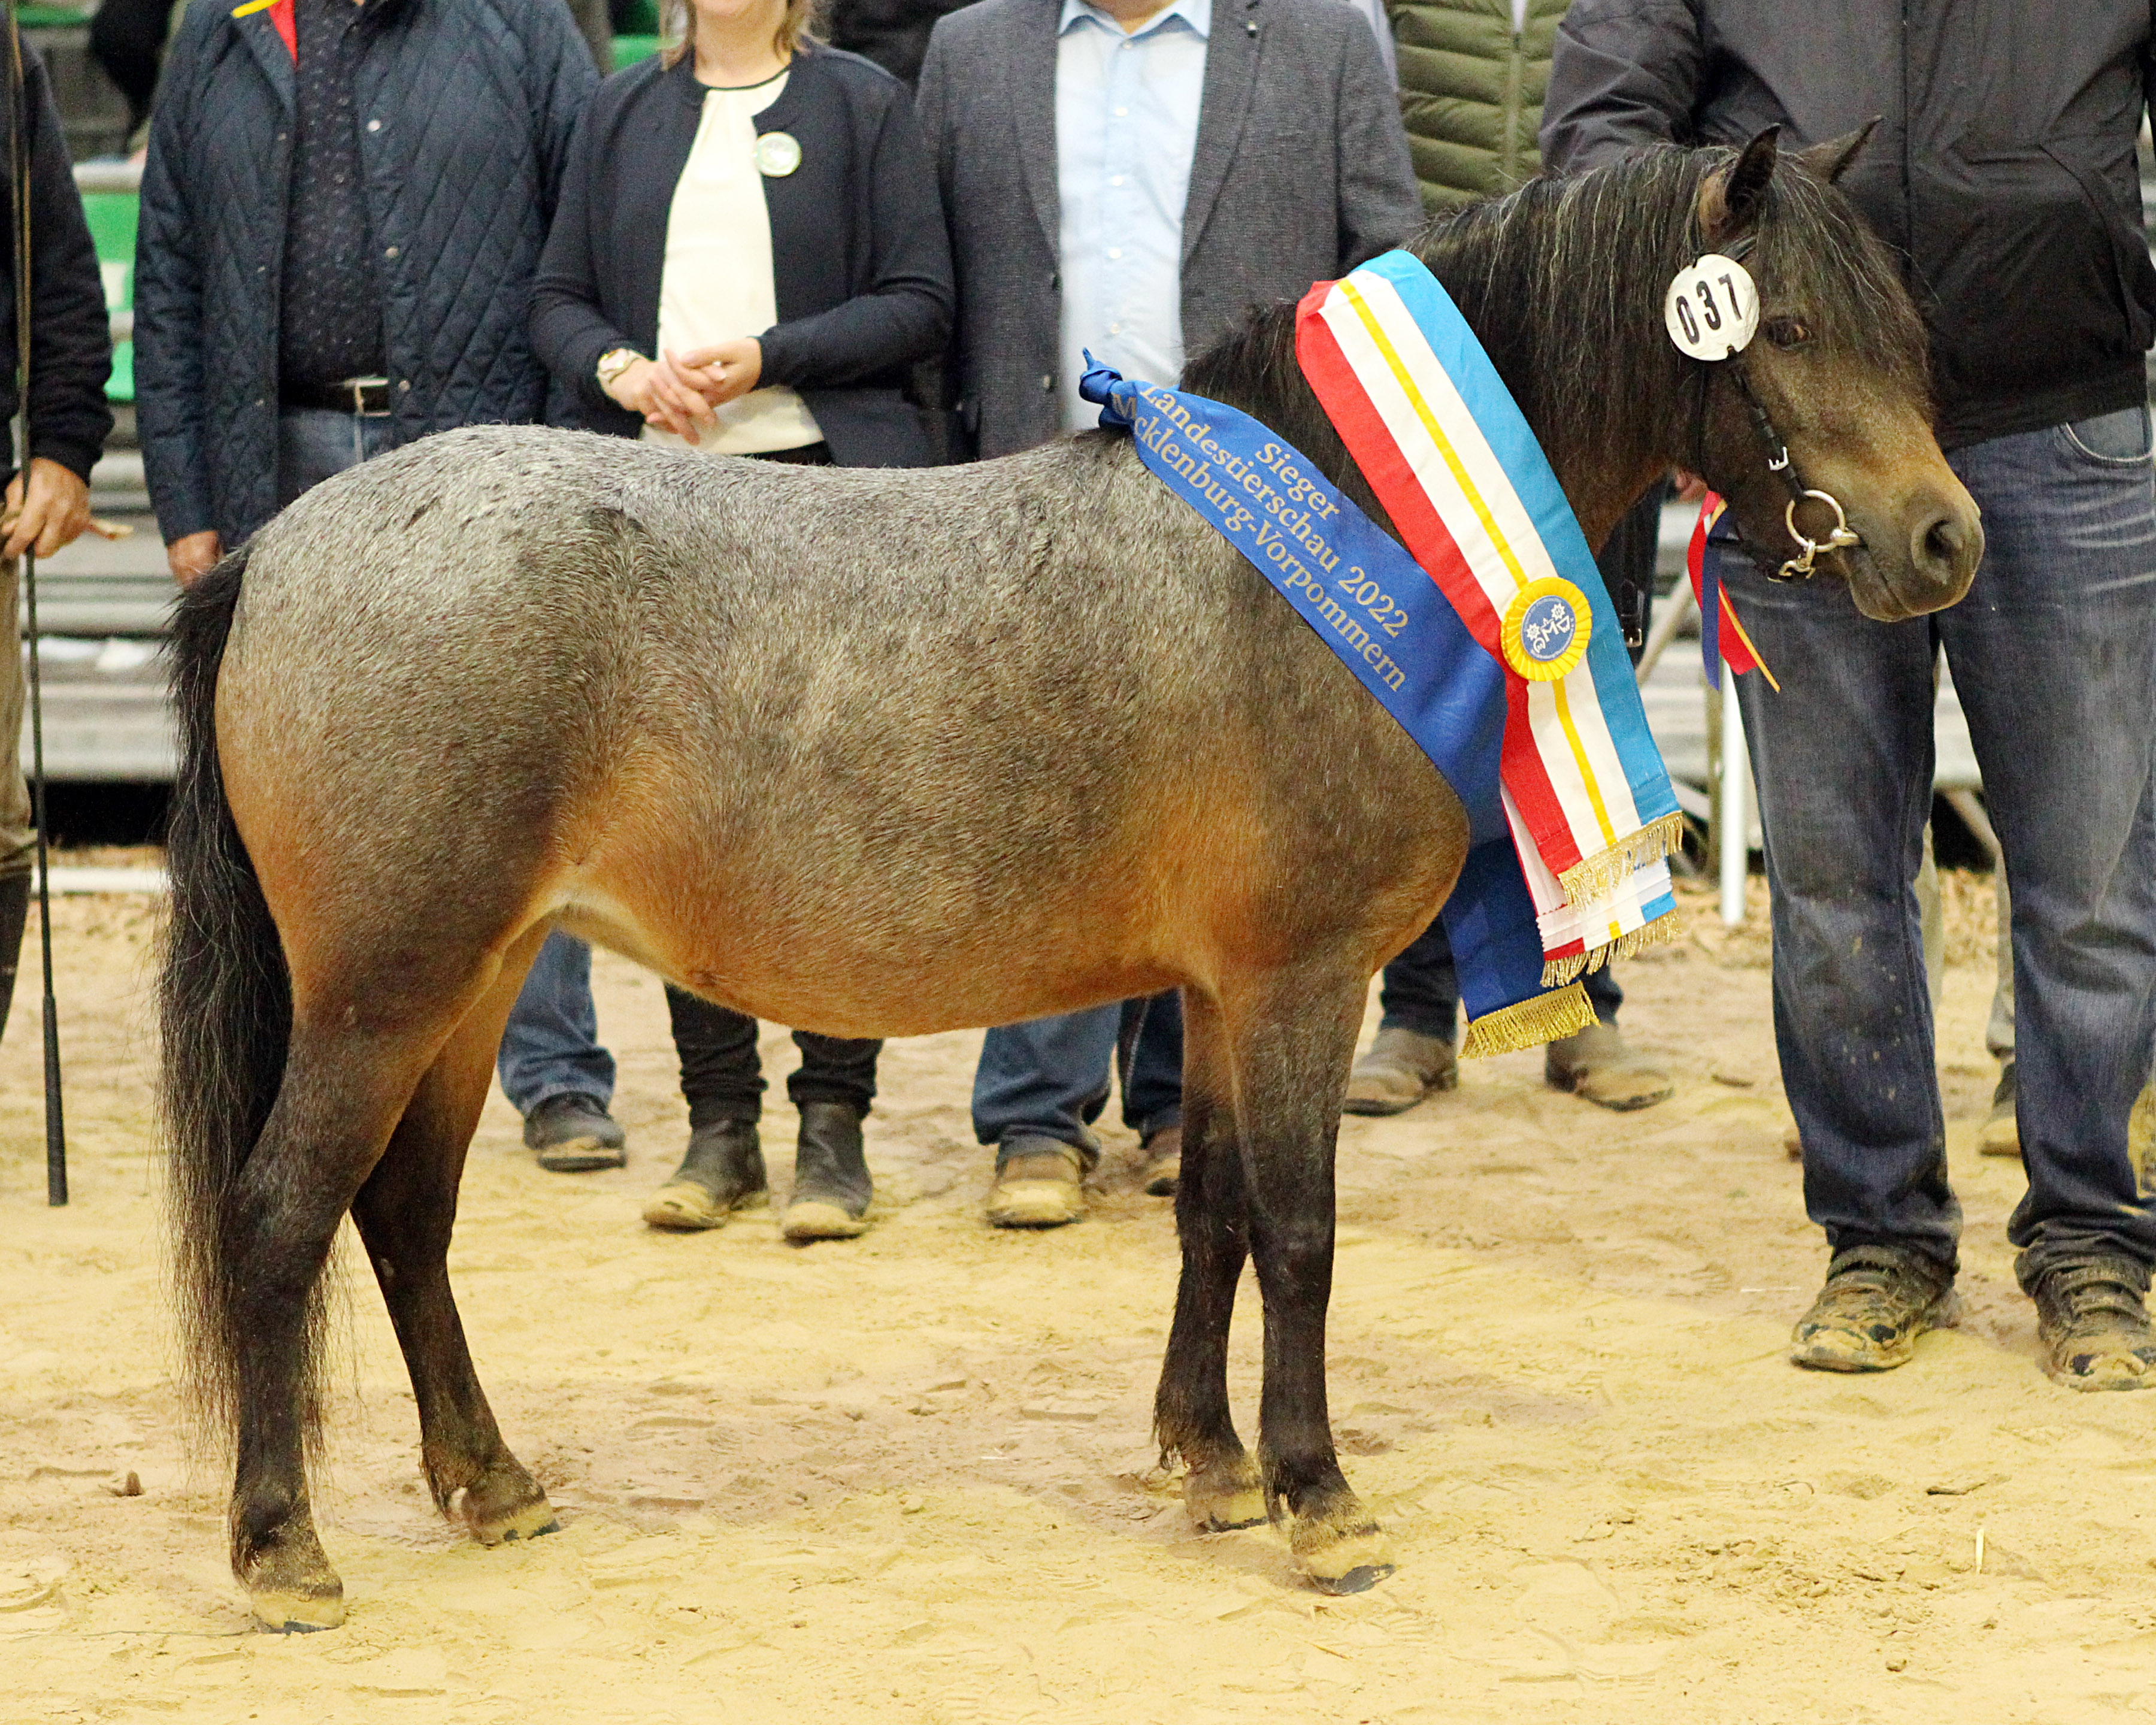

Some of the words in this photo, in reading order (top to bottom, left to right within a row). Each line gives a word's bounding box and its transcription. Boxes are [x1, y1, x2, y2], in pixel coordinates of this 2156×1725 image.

[1676, 273, 1743, 346] 037
[1112, 392, 1406, 691] Mcklenburg-Vorpommern
[1140, 387, 1340, 573] Landestierschau
[1337, 566, 1409, 637] 2022
[1255, 442, 1340, 521] Sieger
